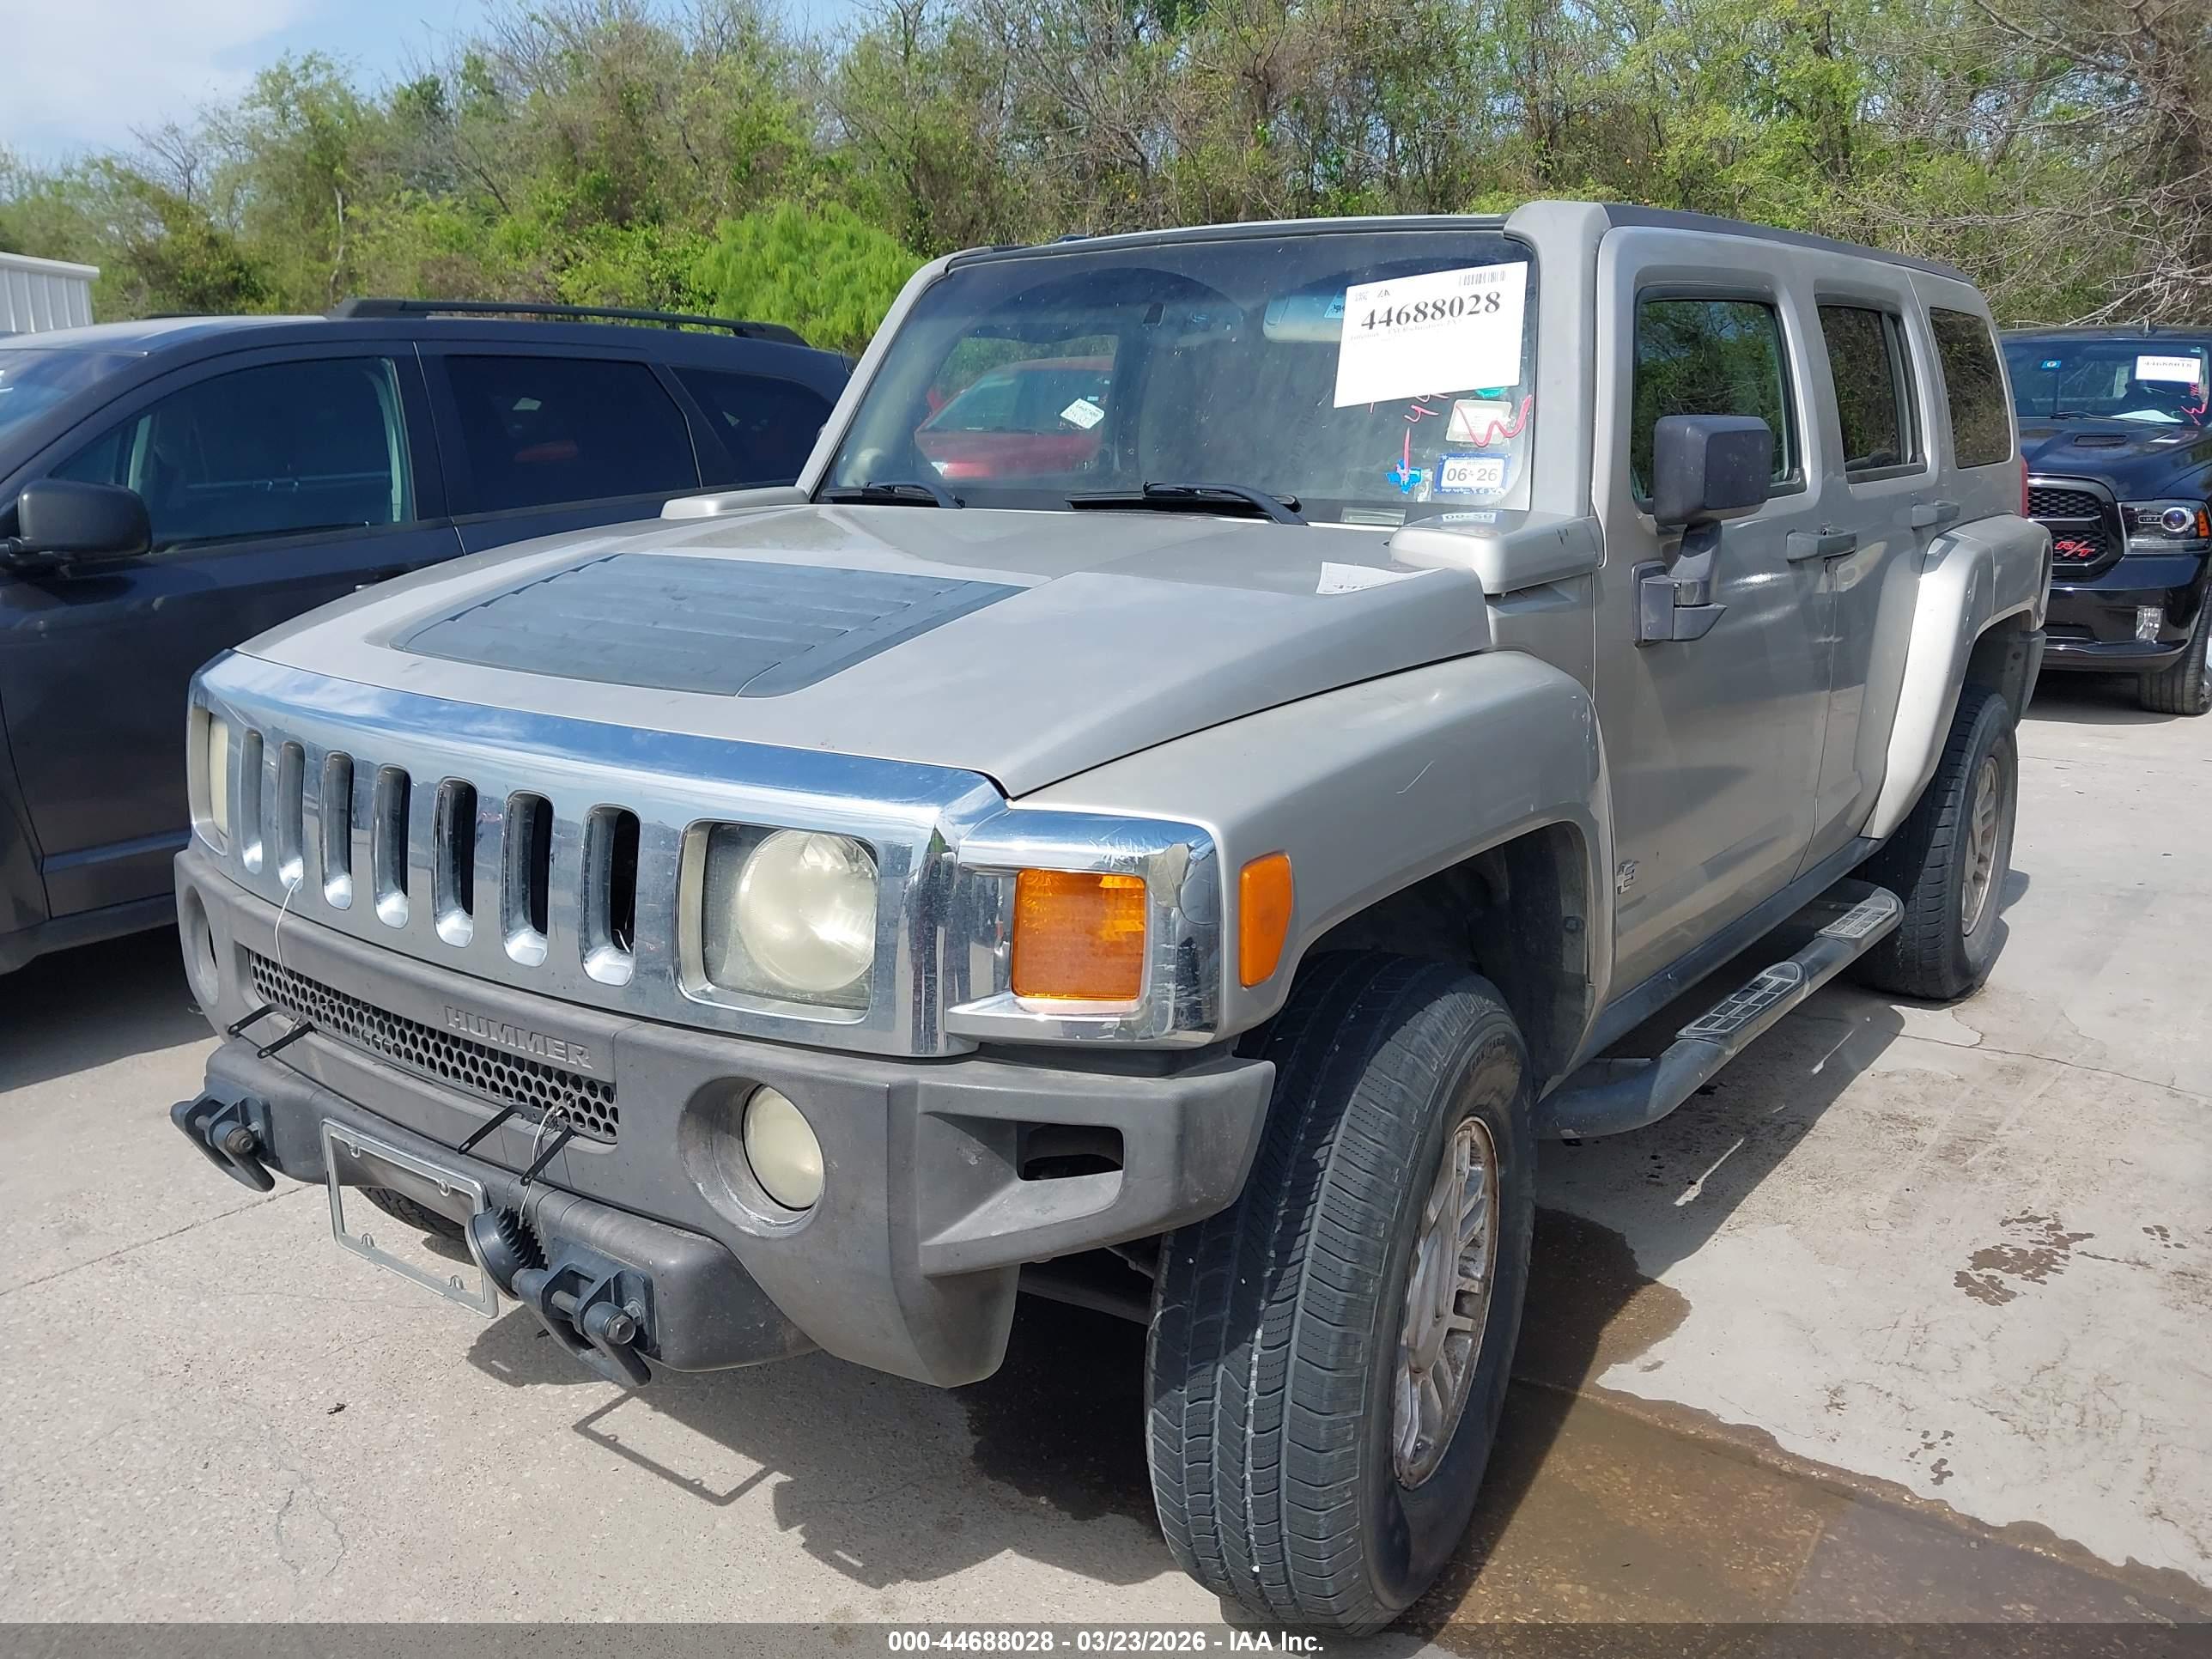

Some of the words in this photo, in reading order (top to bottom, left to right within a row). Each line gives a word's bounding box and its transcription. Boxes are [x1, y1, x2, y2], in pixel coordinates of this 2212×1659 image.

[1360, 290, 1501, 330] 44688028
[2053, 540, 2096, 557] R/T
[444, 1005, 594, 1070] HUMMER
